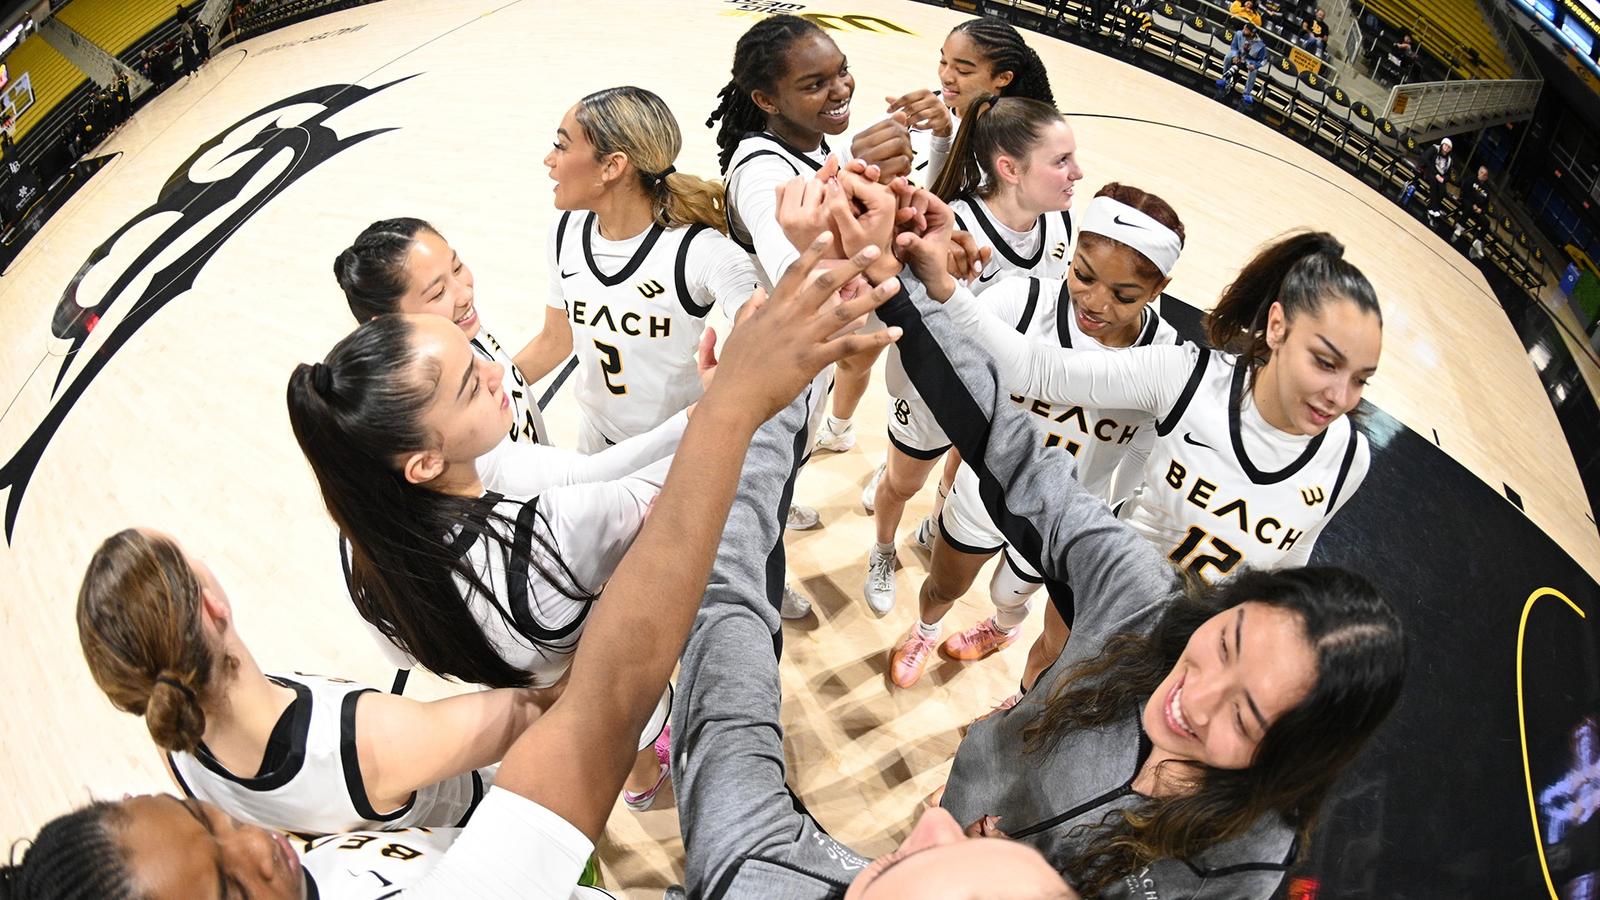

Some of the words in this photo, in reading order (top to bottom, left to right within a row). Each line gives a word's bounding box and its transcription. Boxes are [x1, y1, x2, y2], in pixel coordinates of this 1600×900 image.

[592, 337, 627, 397] 2
[1164, 458, 1304, 552] BEACH
[1167, 525, 1243, 587] 12
